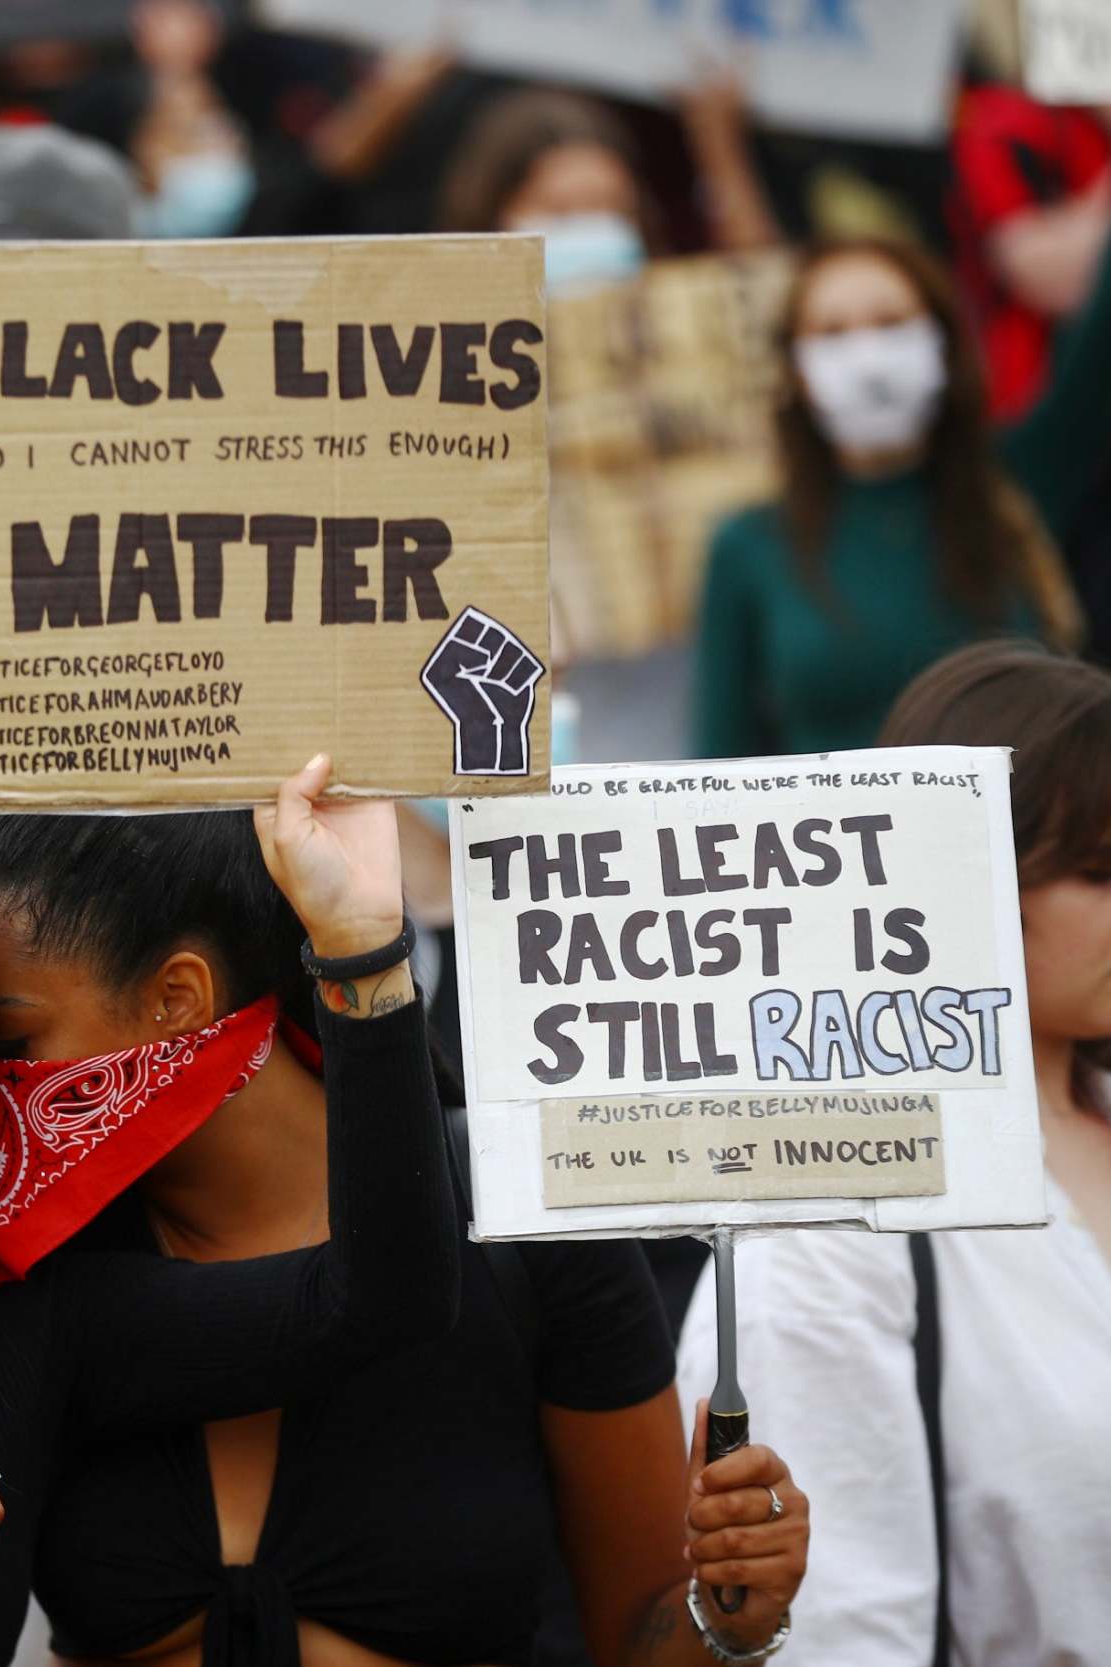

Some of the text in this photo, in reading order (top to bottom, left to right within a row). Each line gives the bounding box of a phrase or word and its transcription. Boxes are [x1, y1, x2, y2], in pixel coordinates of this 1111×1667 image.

[273, 319, 543, 411] LIVES
[28, 444, 34, 469] I
[71, 439, 191, 467] CANNOT
[215, 435, 304, 461] STRESS
[314, 434, 367, 458] THIS
[389, 432, 509, 460] ENOUGH)
[11, 513, 453, 633] MATTER
[604, 780, 628, 796] BE
[639, 776, 735, 793] GRATEFUL
[742, 775, 798, 791] WE'RE
[806, 773, 842, 788] THE
[851, 772, 901, 786] LEAST
[469, 814, 892, 901] THE LEAST
[517, 907, 930, 984] RACIST IS
[527, 987, 1011, 1084] STILL RACIST
[578, 1095, 934, 1124] #JUSTICEFORBELLYMUJINGA
[547, 1137, 938, 1169] THE UK IS NOT INNOCENT
